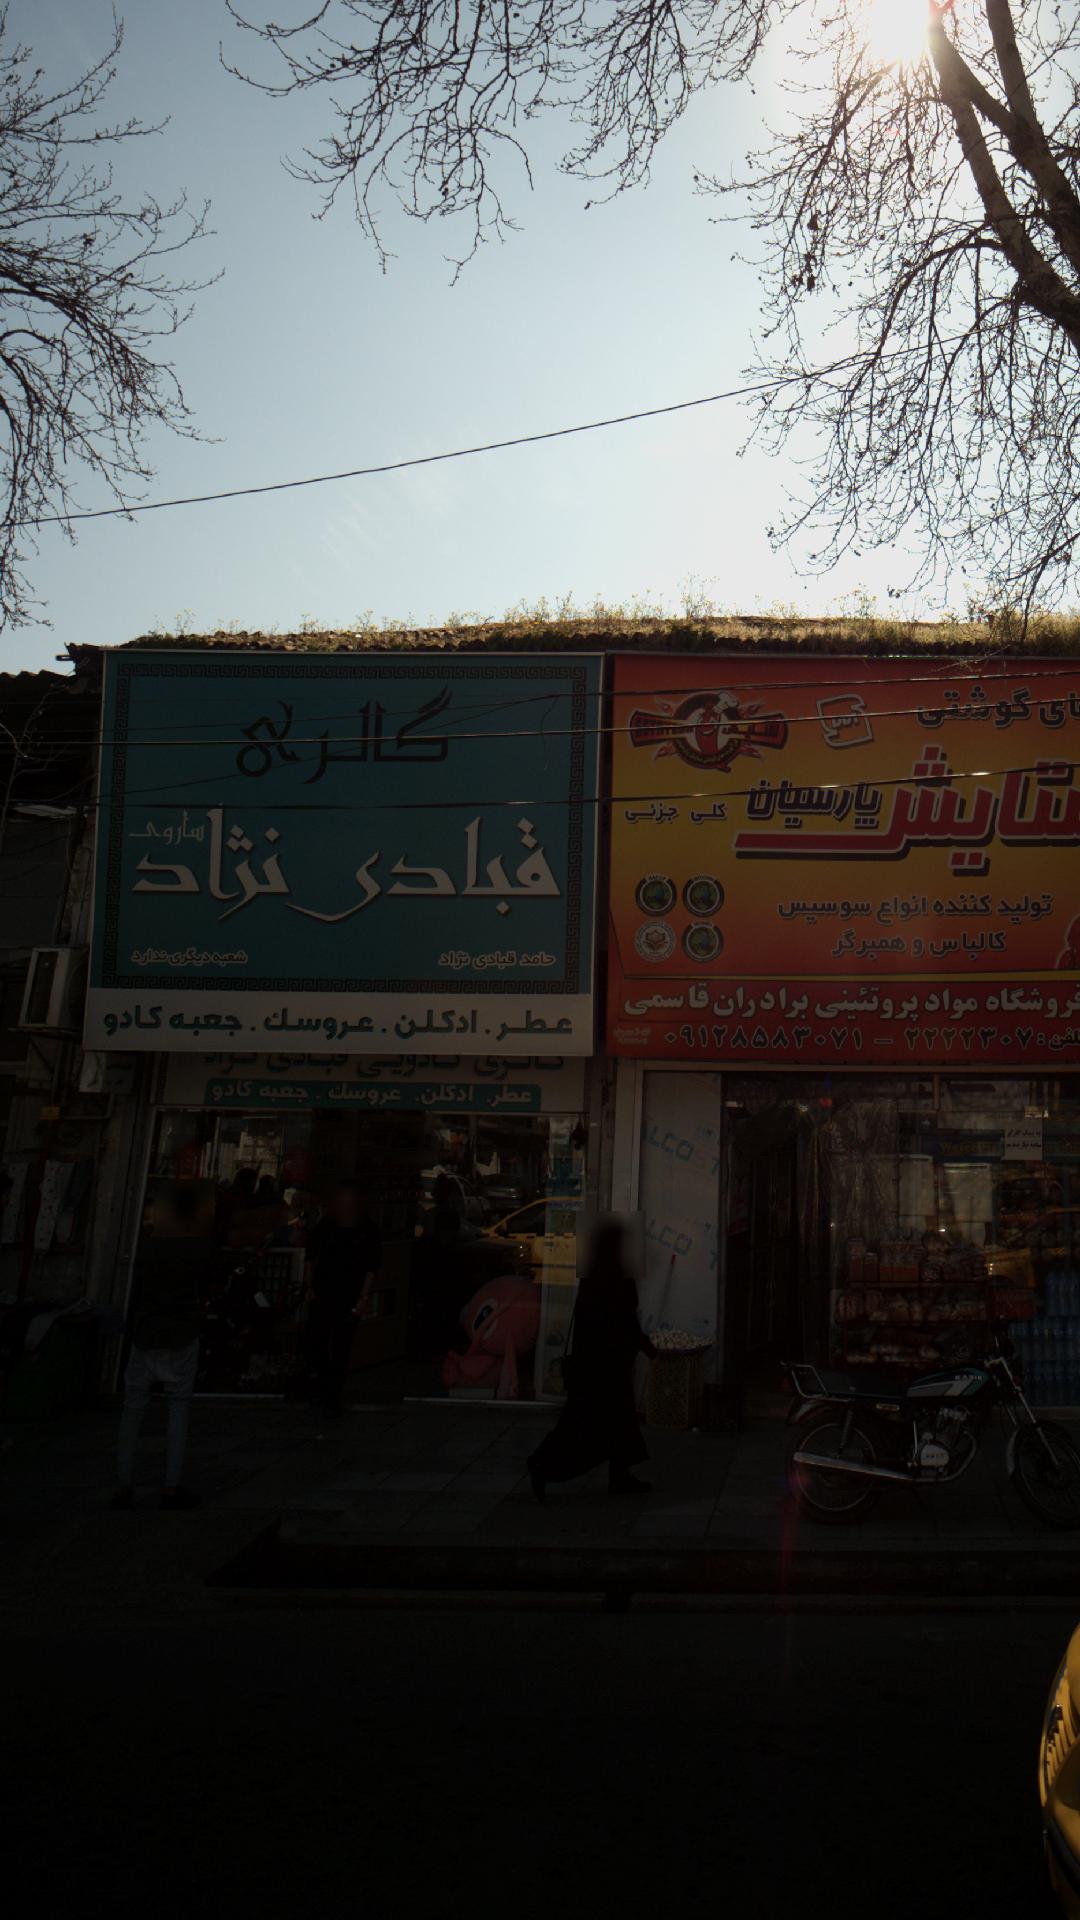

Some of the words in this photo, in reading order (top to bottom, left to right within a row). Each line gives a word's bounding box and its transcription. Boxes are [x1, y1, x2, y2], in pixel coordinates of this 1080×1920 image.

[915, 685, 1033, 728] گوشتی
[690, 803, 727, 823] کلی
[735, 744, 1080, 876] تایش
[131, 802, 290, 921] نژاد
[285, 816, 561, 921] قبادی
[777, 899, 871, 925] سوسیس
[876, 896, 928, 926] انواع
[932, 893, 991, 917] کننده
[997, 893, 1053, 925] تولید
[131, 949, 169, 966] ندارد
[168, 947, 211, 967] دیگری
[831, 928, 906, 960] همبرگر
[911, 937, 923, 956] و
[930, 931, 1007, 962] کالباس
[213, 949, 249, 967] شعبه
[438, 951, 470, 970] نژاد
[472, 951, 516, 970] قبادی
[519, 951, 557, 966] حامد
[623, 984, 711, 1016] قاسمی
[712, 986, 809, 1018] برادران
[815, 985, 920, 1021] پروتئینی
[924, 988, 978, 1019] مواد
[103, 1005, 163, 1034] کادو
[169, 1013, 243, 1036] جعبه
[210, 1081, 254, 1101] کادو
[258, 1085, 310, 1103] جعبه
